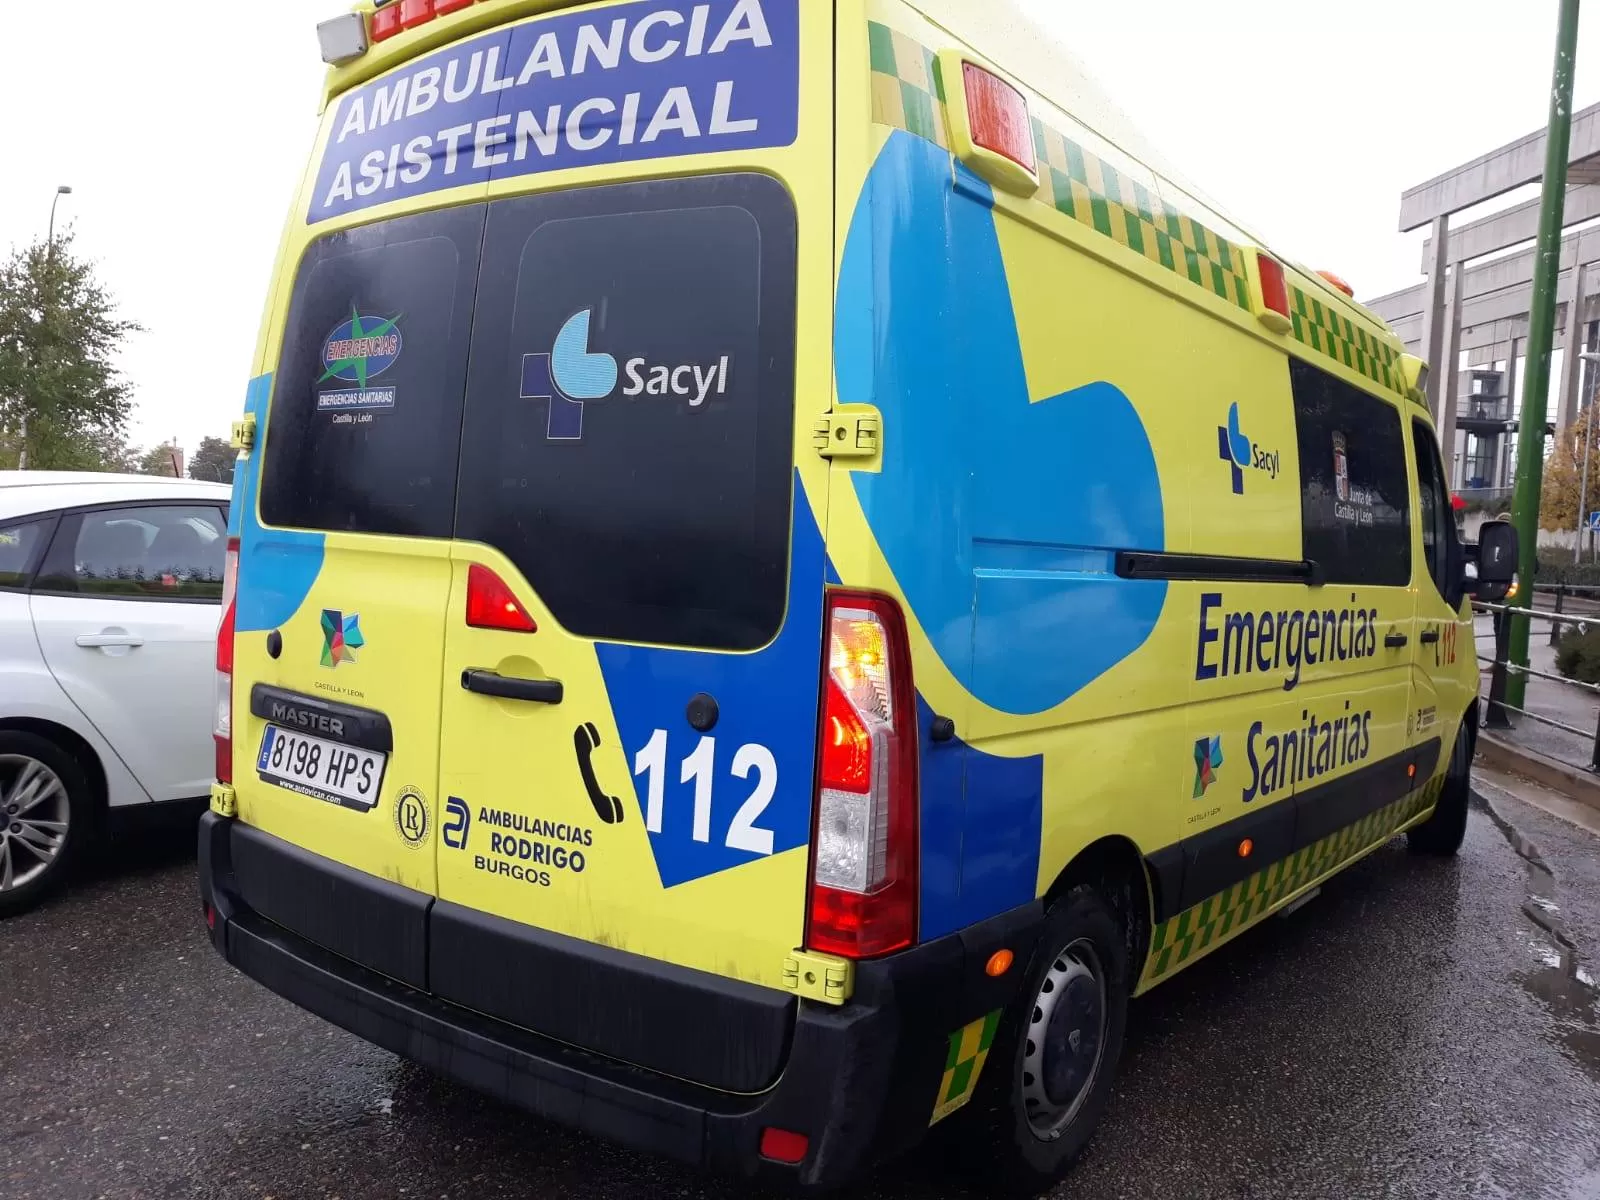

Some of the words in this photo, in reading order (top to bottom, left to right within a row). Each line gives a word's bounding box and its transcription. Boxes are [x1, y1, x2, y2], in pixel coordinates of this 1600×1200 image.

[337, 0, 772, 144] AMBULANCIA
[323, 80, 759, 208] ASISTENCIAL
[327, 335, 398, 361] EMERGENCIAS
[319, 393, 358, 406] EMERGENCIAS
[358, 390, 393, 404] SANITARIAS
[622, 355, 729, 406] Sacyl
[332, 414, 352, 423] Castilla
[353, 415, 357, 424] y
[358, 412, 373, 422] León
[1252, 443, 1280, 480] Sacyl
[1196, 592, 1377, 691] Emergencias
[1442, 622, 1456, 665] 112
[314, 681, 341, 693] CASTILLA
[272, 702, 345, 736] MASTER
[271, 734, 322, 779] 8198
[325, 748, 375, 795] HPS
[1242, 700, 1371, 803] Sanitarias
[279, 780, 342, 805] www.autovican.com
[634, 728, 778, 856] 112
[478, 807, 593, 847] AMBULANCIAS
[474, 855, 551, 888] BURGOS
[491, 832, 585, 873] RODRIGO
